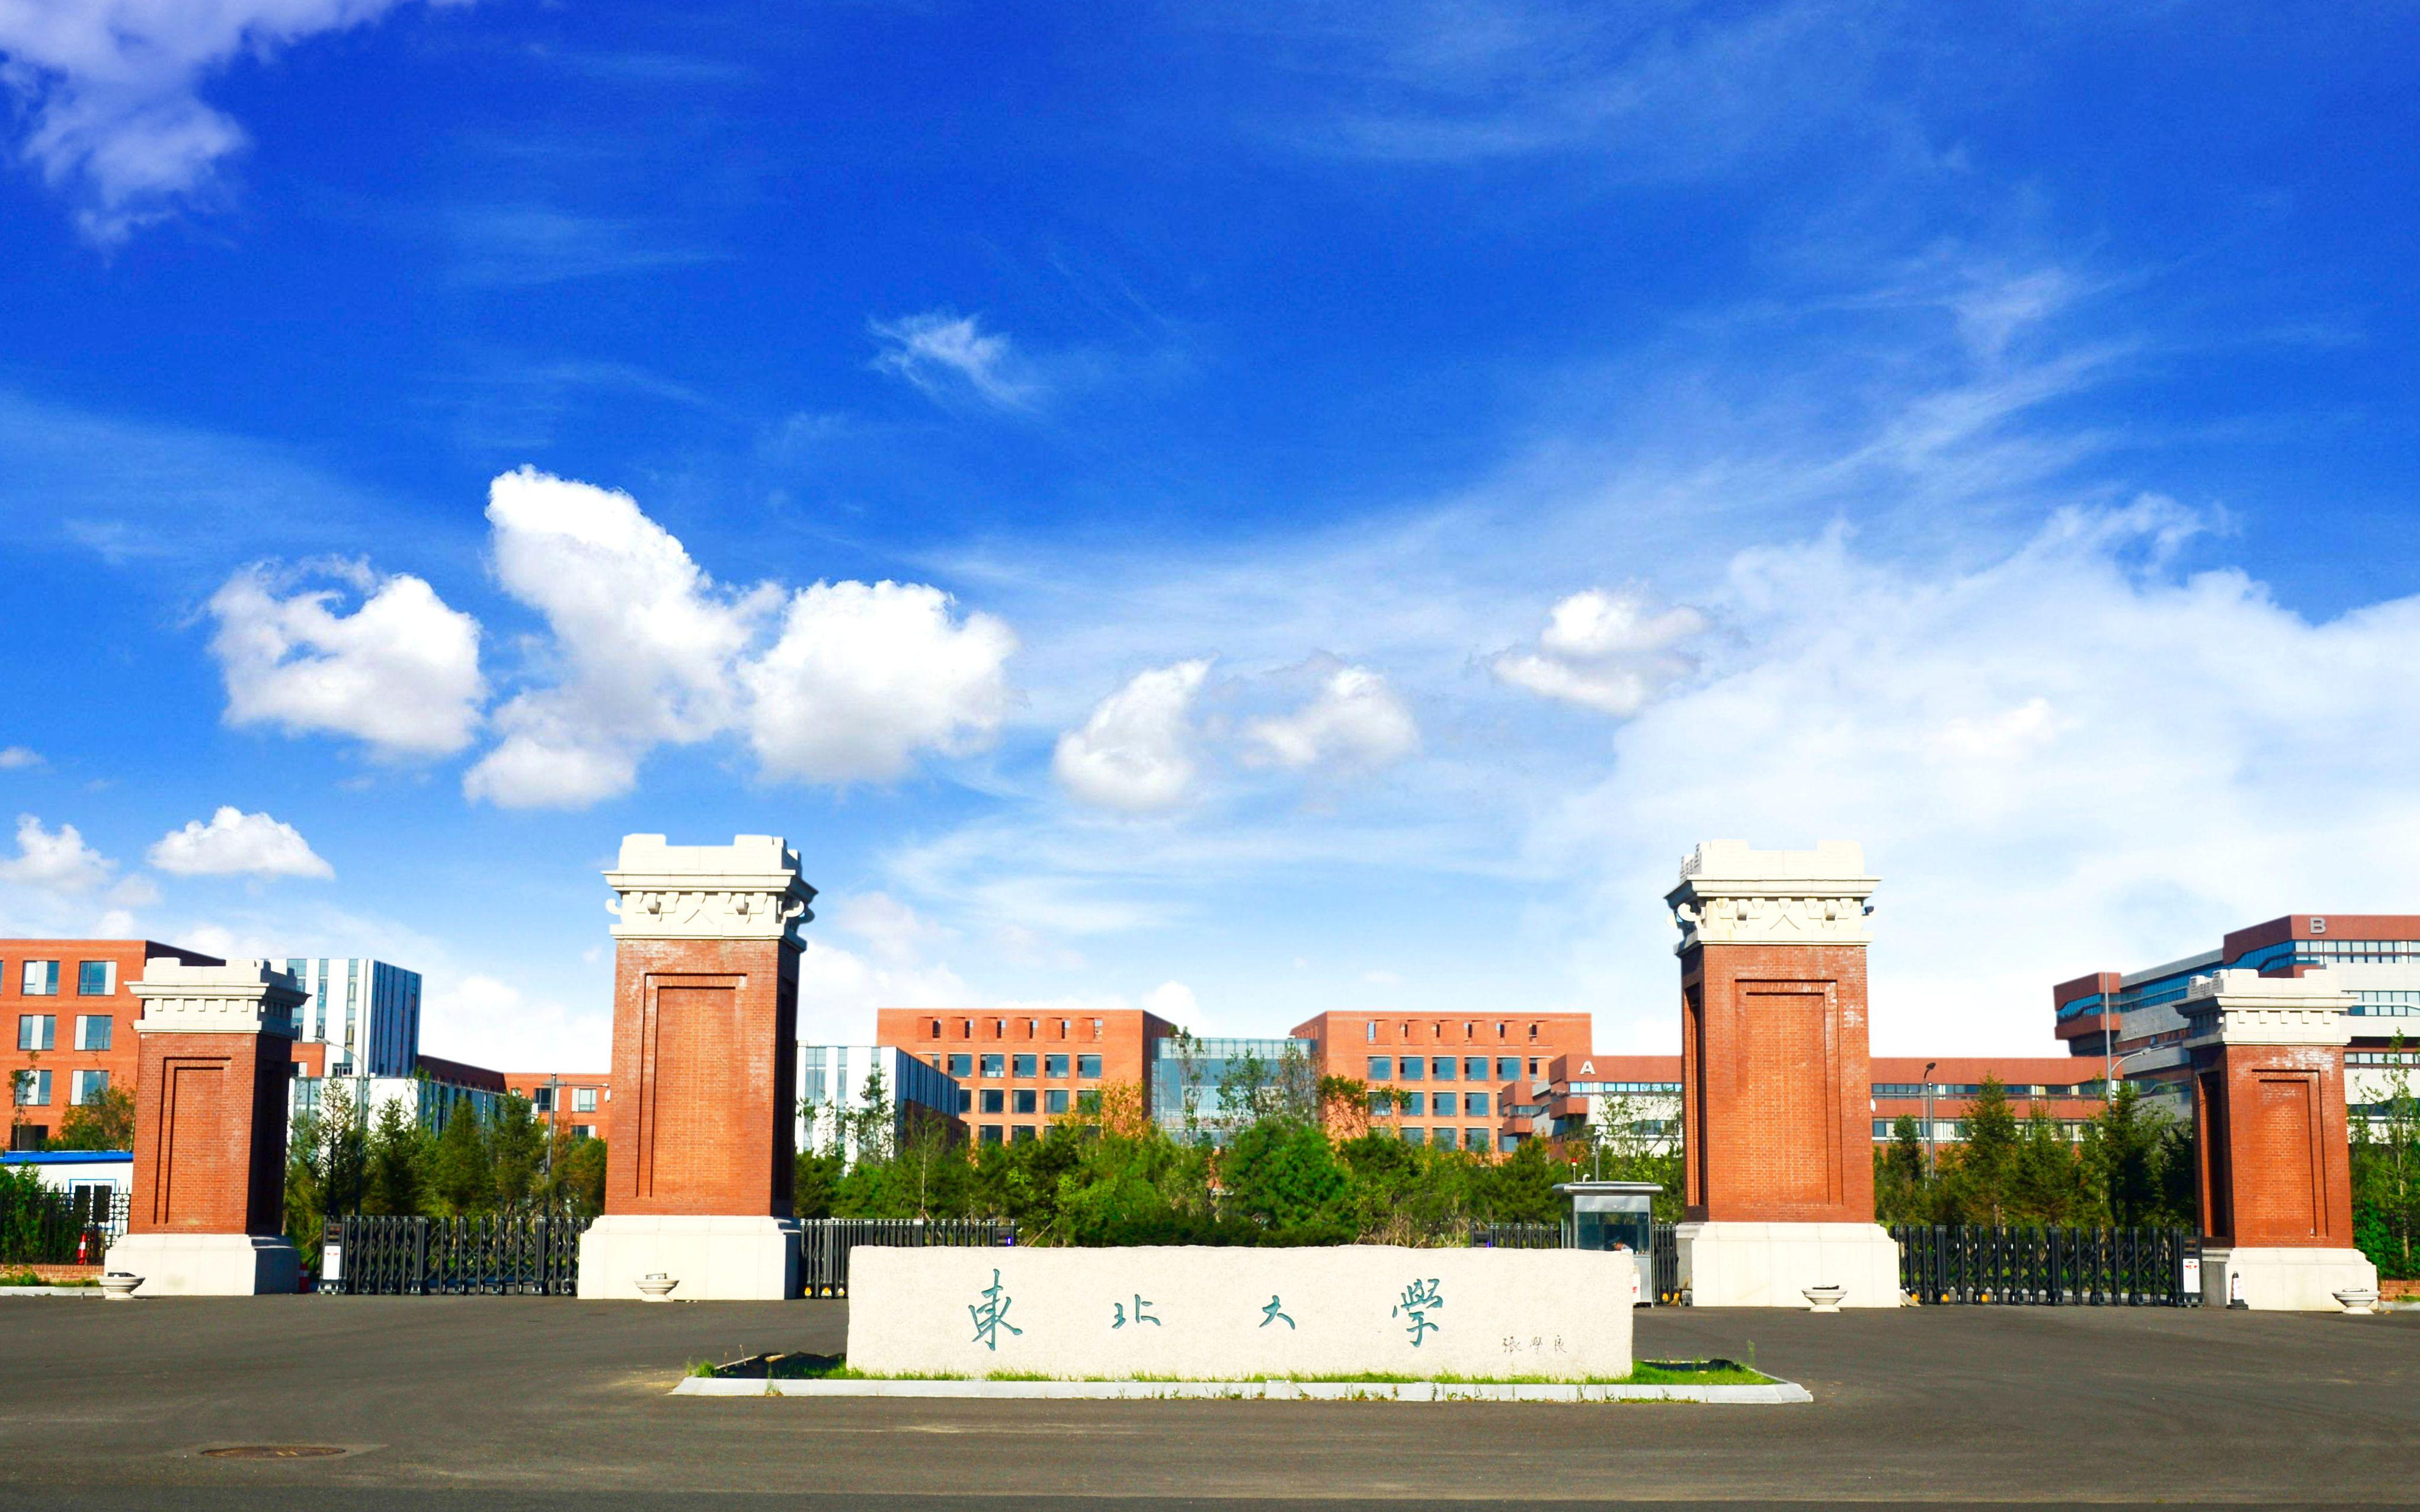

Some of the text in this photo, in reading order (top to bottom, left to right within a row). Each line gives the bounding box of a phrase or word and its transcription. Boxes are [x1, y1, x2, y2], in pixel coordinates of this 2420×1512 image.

[2310, 918, 2326, 934] B
[1579, 1061, 1595, 1075] A
[968, 1268, 1443, 1351] 東北大學
